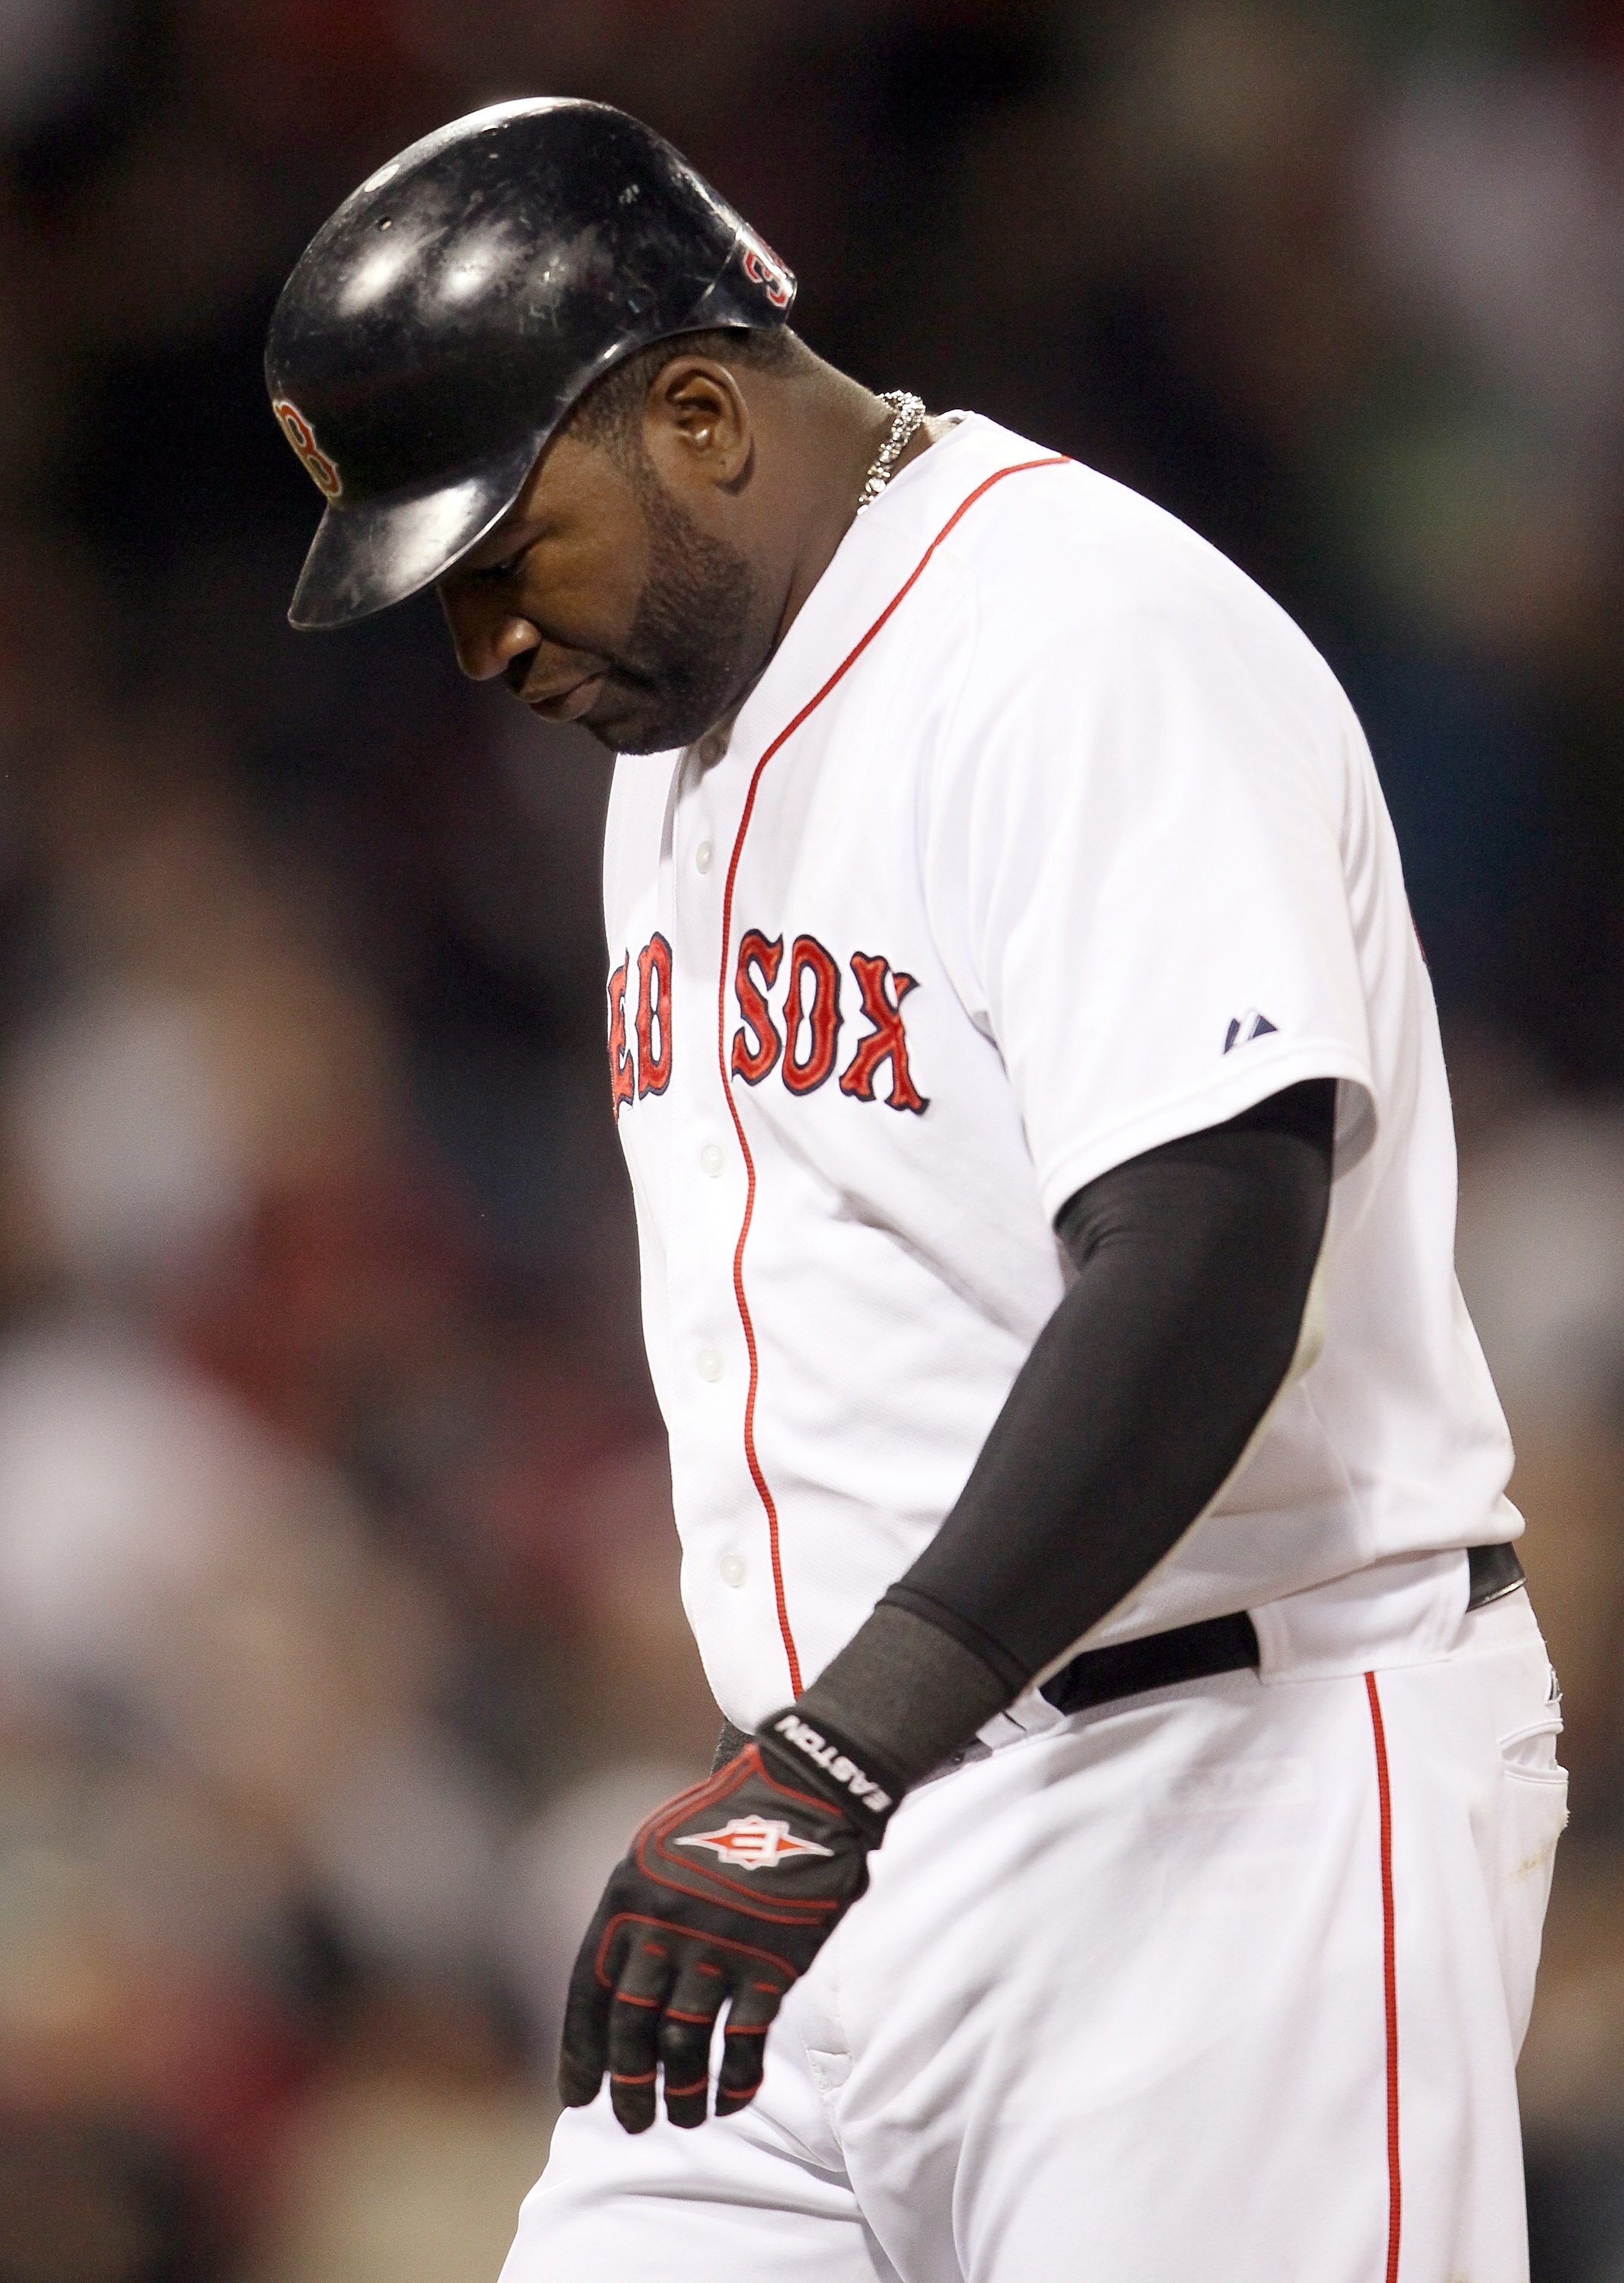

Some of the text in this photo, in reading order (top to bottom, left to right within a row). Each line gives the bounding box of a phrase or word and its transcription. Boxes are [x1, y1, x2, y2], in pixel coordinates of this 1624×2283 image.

[742, 247, 788, 309] 3
[272, 399, 342, 498] B
[608, 928, 931, 1126] ED SOX
[774, 1714, 893, 1813] EASTON
